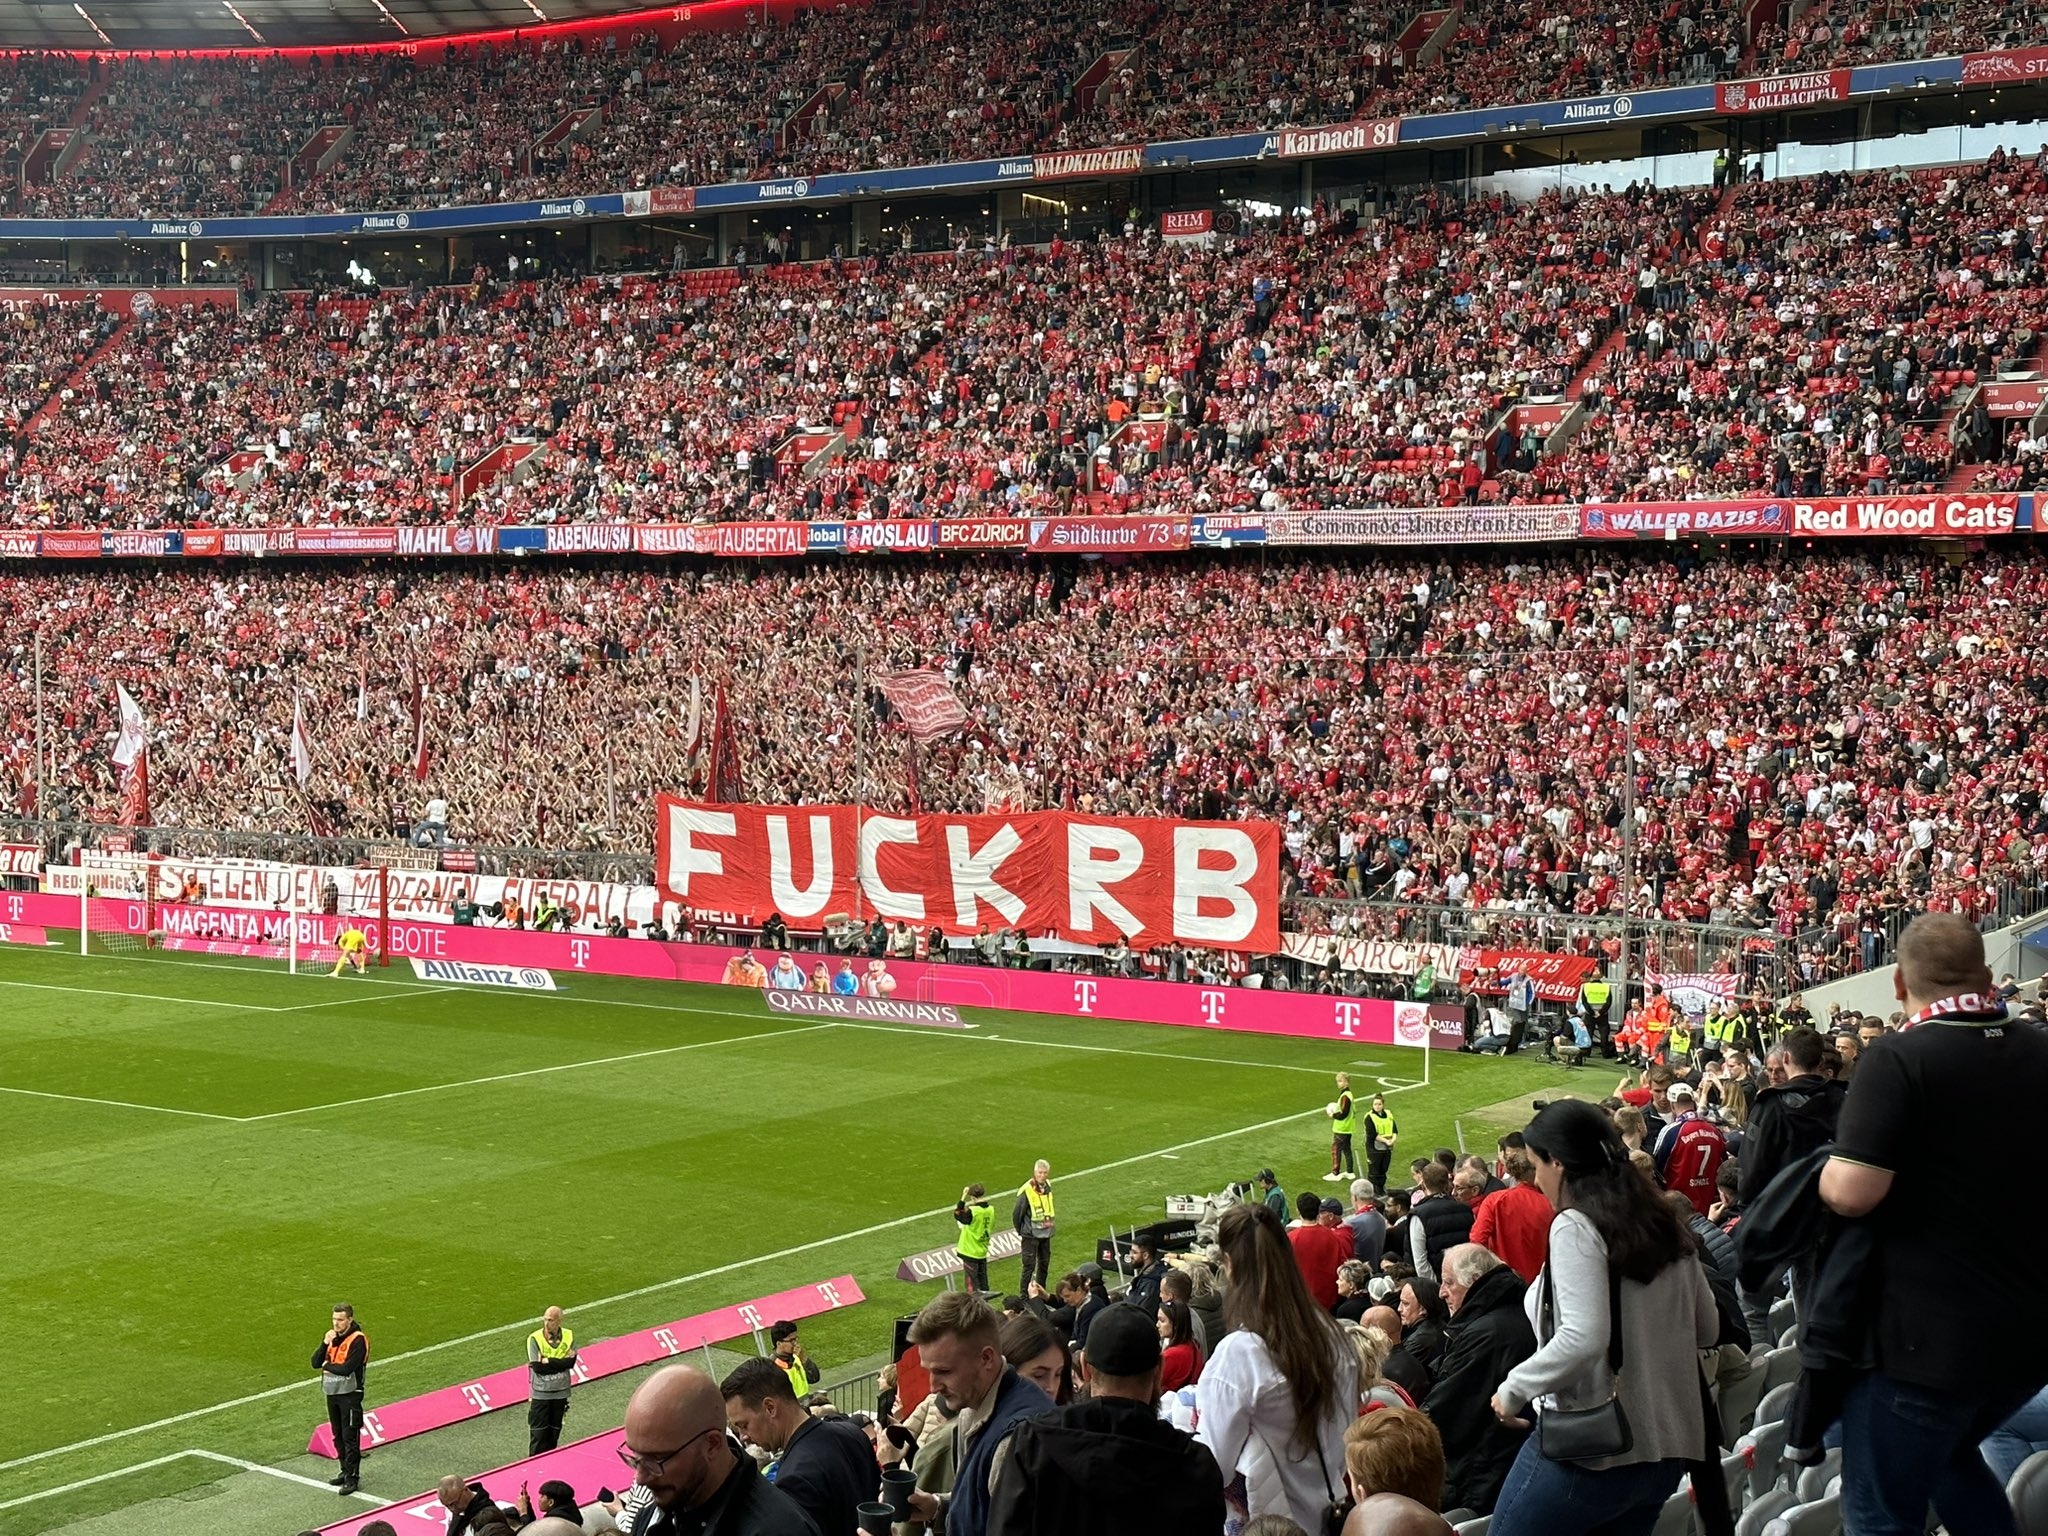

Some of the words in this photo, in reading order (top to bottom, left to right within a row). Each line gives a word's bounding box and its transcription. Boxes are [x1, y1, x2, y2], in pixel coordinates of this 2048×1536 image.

[1759, 74, 1832, 94] ROT-WEISS
[1748, 86, 1839, 110] KOLLBACHTAL
[1564, 103, 1611, 119] Allianz
[1284, 127, 1364, 154] Karbach
[1033, 149, 1142, 178] WALDKIRCHEN
[759, 184, 793, 196] Allianz
[540, 203, 572, 216] Allianz
[1166, 212, 1204, 228] RHM
[151, 223, 188, 235] Allianz
[362, 215, 395, 228] Allianz
[1206, 517, 1232, 528] LETZTE
[1302, 514, 1400, 536] Commando
[1610, 508, 1690, 531] WÄLLER
[1695, 509, 1757, 529] BAZIS
[1795, 503, 1847, 530] Red
[1857, 502, 1936, 530] Wood
[1945, 501, 2014, 528] Cats
[547, 527, 631, 551] RABENAU/SN
[717, 527, 807, 553] TAUBERTAL
[807, 528, 841, 542] lobal
[860, 522, 930, 547] RÖSLAU
[940, 523, 971, 543] BFC
[971, 520, 1026, 543] ZÜRICH
[1051, 522, 1139, 545] Südkurve
[114, 534, 164, 555] SEELAND
[668, 805, 1029, 927] FUCK
[1066, 823, 1259, 942] RB
[128, 905, 146, 931] DI
[162, 908, 259, 939] MAGENTA
[334, 920, 446, 957] AGBOTE
[424, 959, 514, 984] Allianz
[1538, 958, 1564, 974] 75
[767, 990, 850, 1014] QATAR
[855, 998, 958, 1024] AIRWAYS
[1432, 1019, 1462, 1031] QATAR
[1984, 1028, 2004, 1038] BOSS
[1697, 1144, 1711, 1176] 7
[1169, 1229, 1197, 1240] BUNDESL
